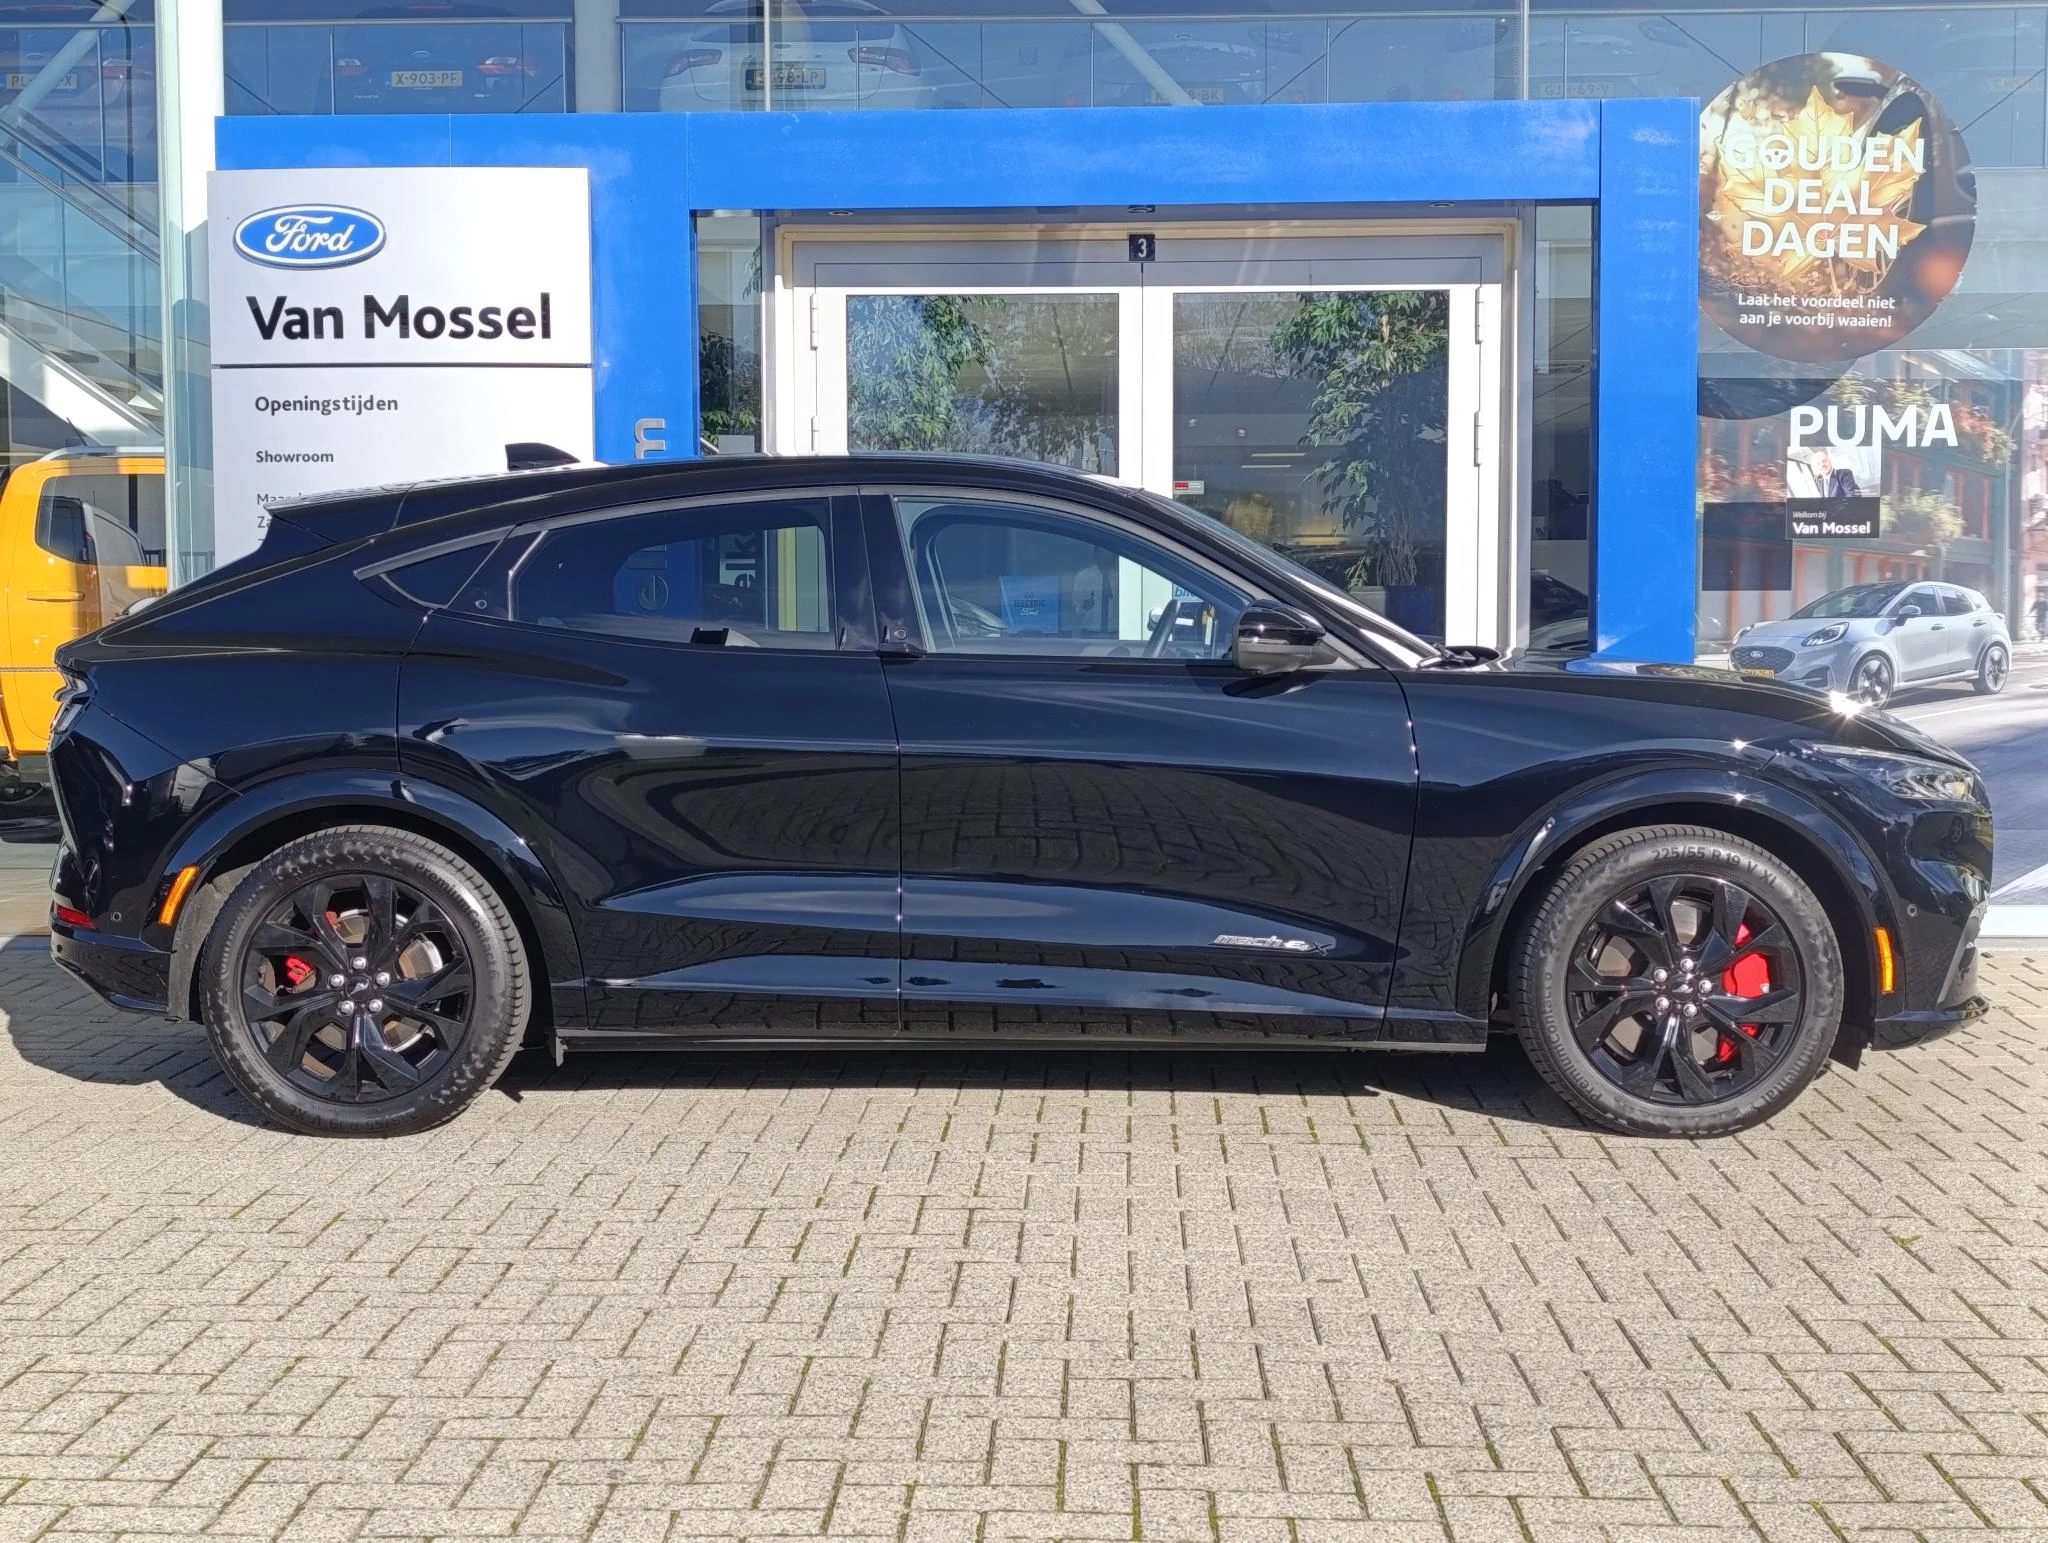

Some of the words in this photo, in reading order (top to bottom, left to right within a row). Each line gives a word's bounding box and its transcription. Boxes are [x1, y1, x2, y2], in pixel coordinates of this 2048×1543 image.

[395, 71, 458, 86] X-903-PF
[1724, 132, 1926, 173] GOUDEN
[1762, 177, 1884, 216] DEAL
[265, 214, 356, 252] Ford
[1740, 220, 1900, 260] DAGEN
[1137, 237, 1147, 258] 3
[1737, 293, 1771, 307] Laat
[1773, 293, 1798, 307] het
[1800, 294, 1864, 309] voordeel
[1867, 296, 1896, 310] niet
[245, 295, 344, 340] Van
[363, 291, 552, 340] Mossel
[1739, 313, 1765, 325] aan
[1766, 311, 1783, 329] je
[1784, 312, 1835, 330] voorbij
[1837, 314, 1893, 328] waaien!
[254, 394, 399, 417] Openingstijden
[1790, 403, 1960, 448] PUMA
[255, 449, 335, 463] Showroom
[1792, 521, 1819, 535] Van
[1822, 520, 1871, 535] Mossel
[1651, 845, 1706, 862] 225/55
[1711, 849, 1722, 863] R
[1725, 851, 1741, 866] 19
[1746, 860, 1758, 874] V
